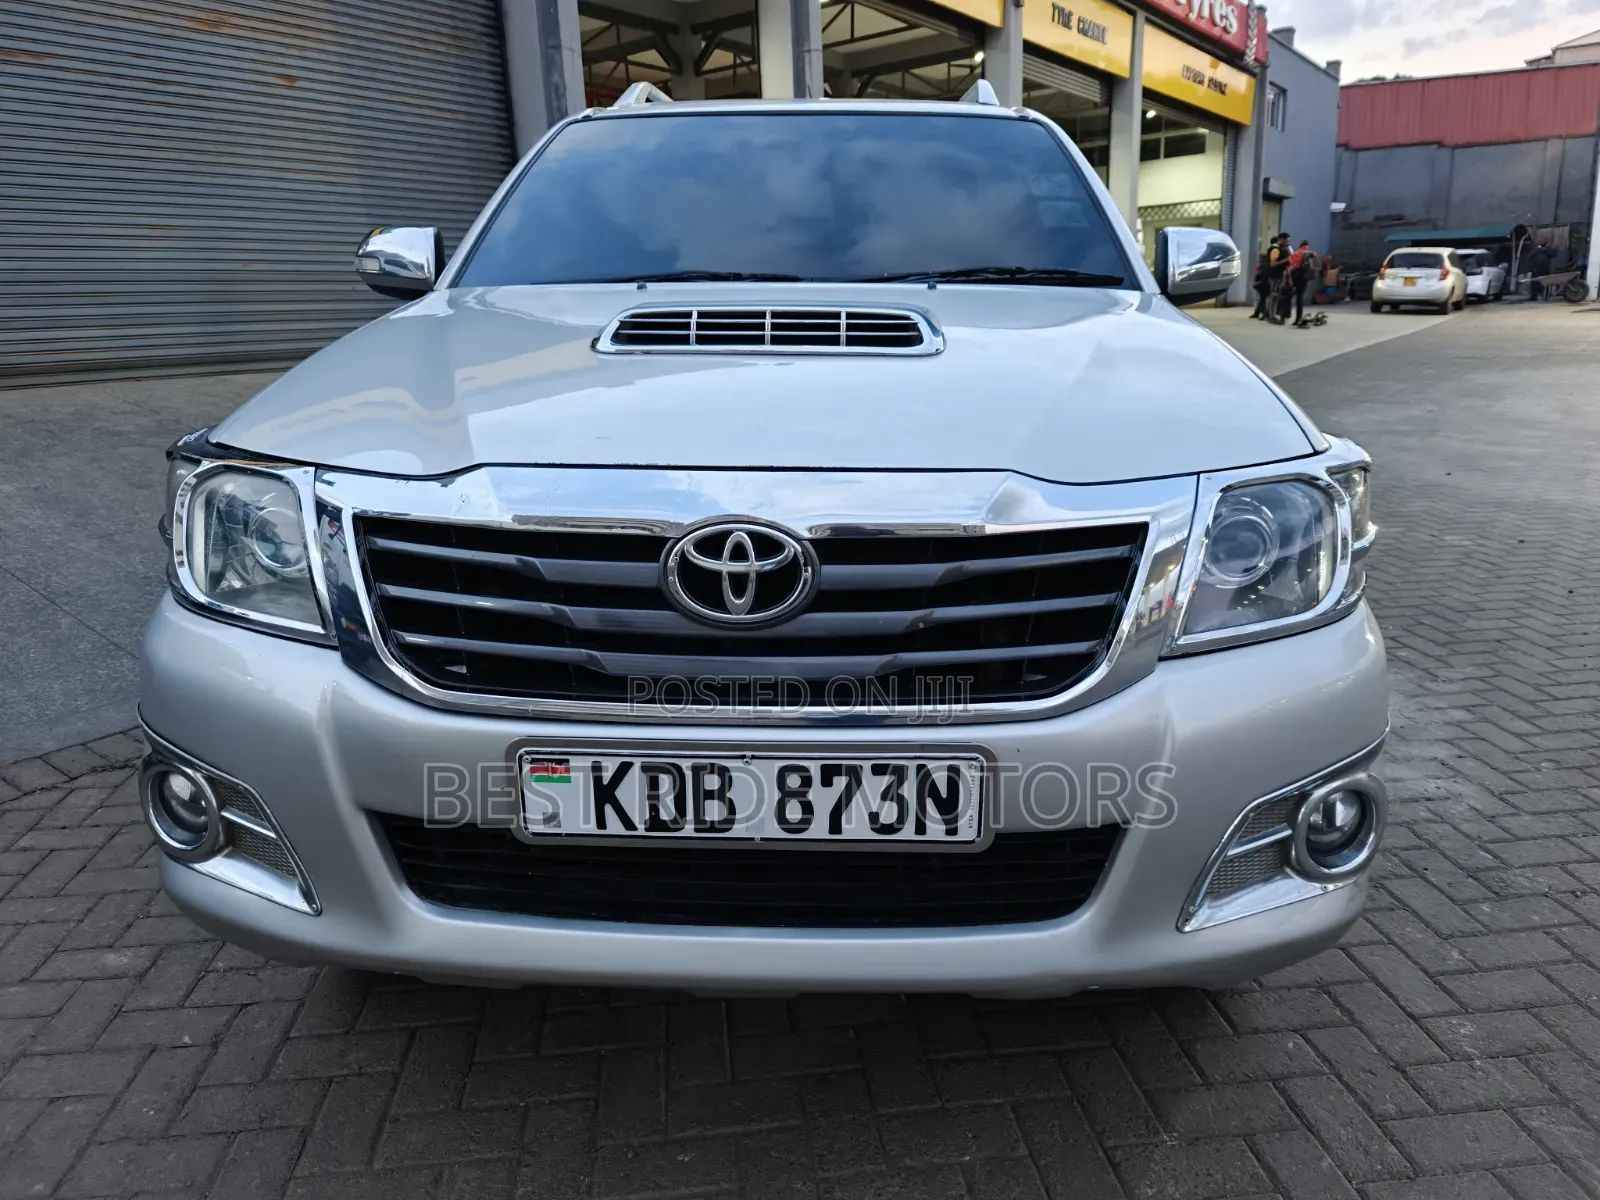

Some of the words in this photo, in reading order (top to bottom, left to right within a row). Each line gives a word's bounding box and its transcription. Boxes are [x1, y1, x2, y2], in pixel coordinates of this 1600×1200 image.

[1177, 0, 1238, 34] yres
[591, 760, 737, 833] KDB
[774, 763, 961, 837] 873N
